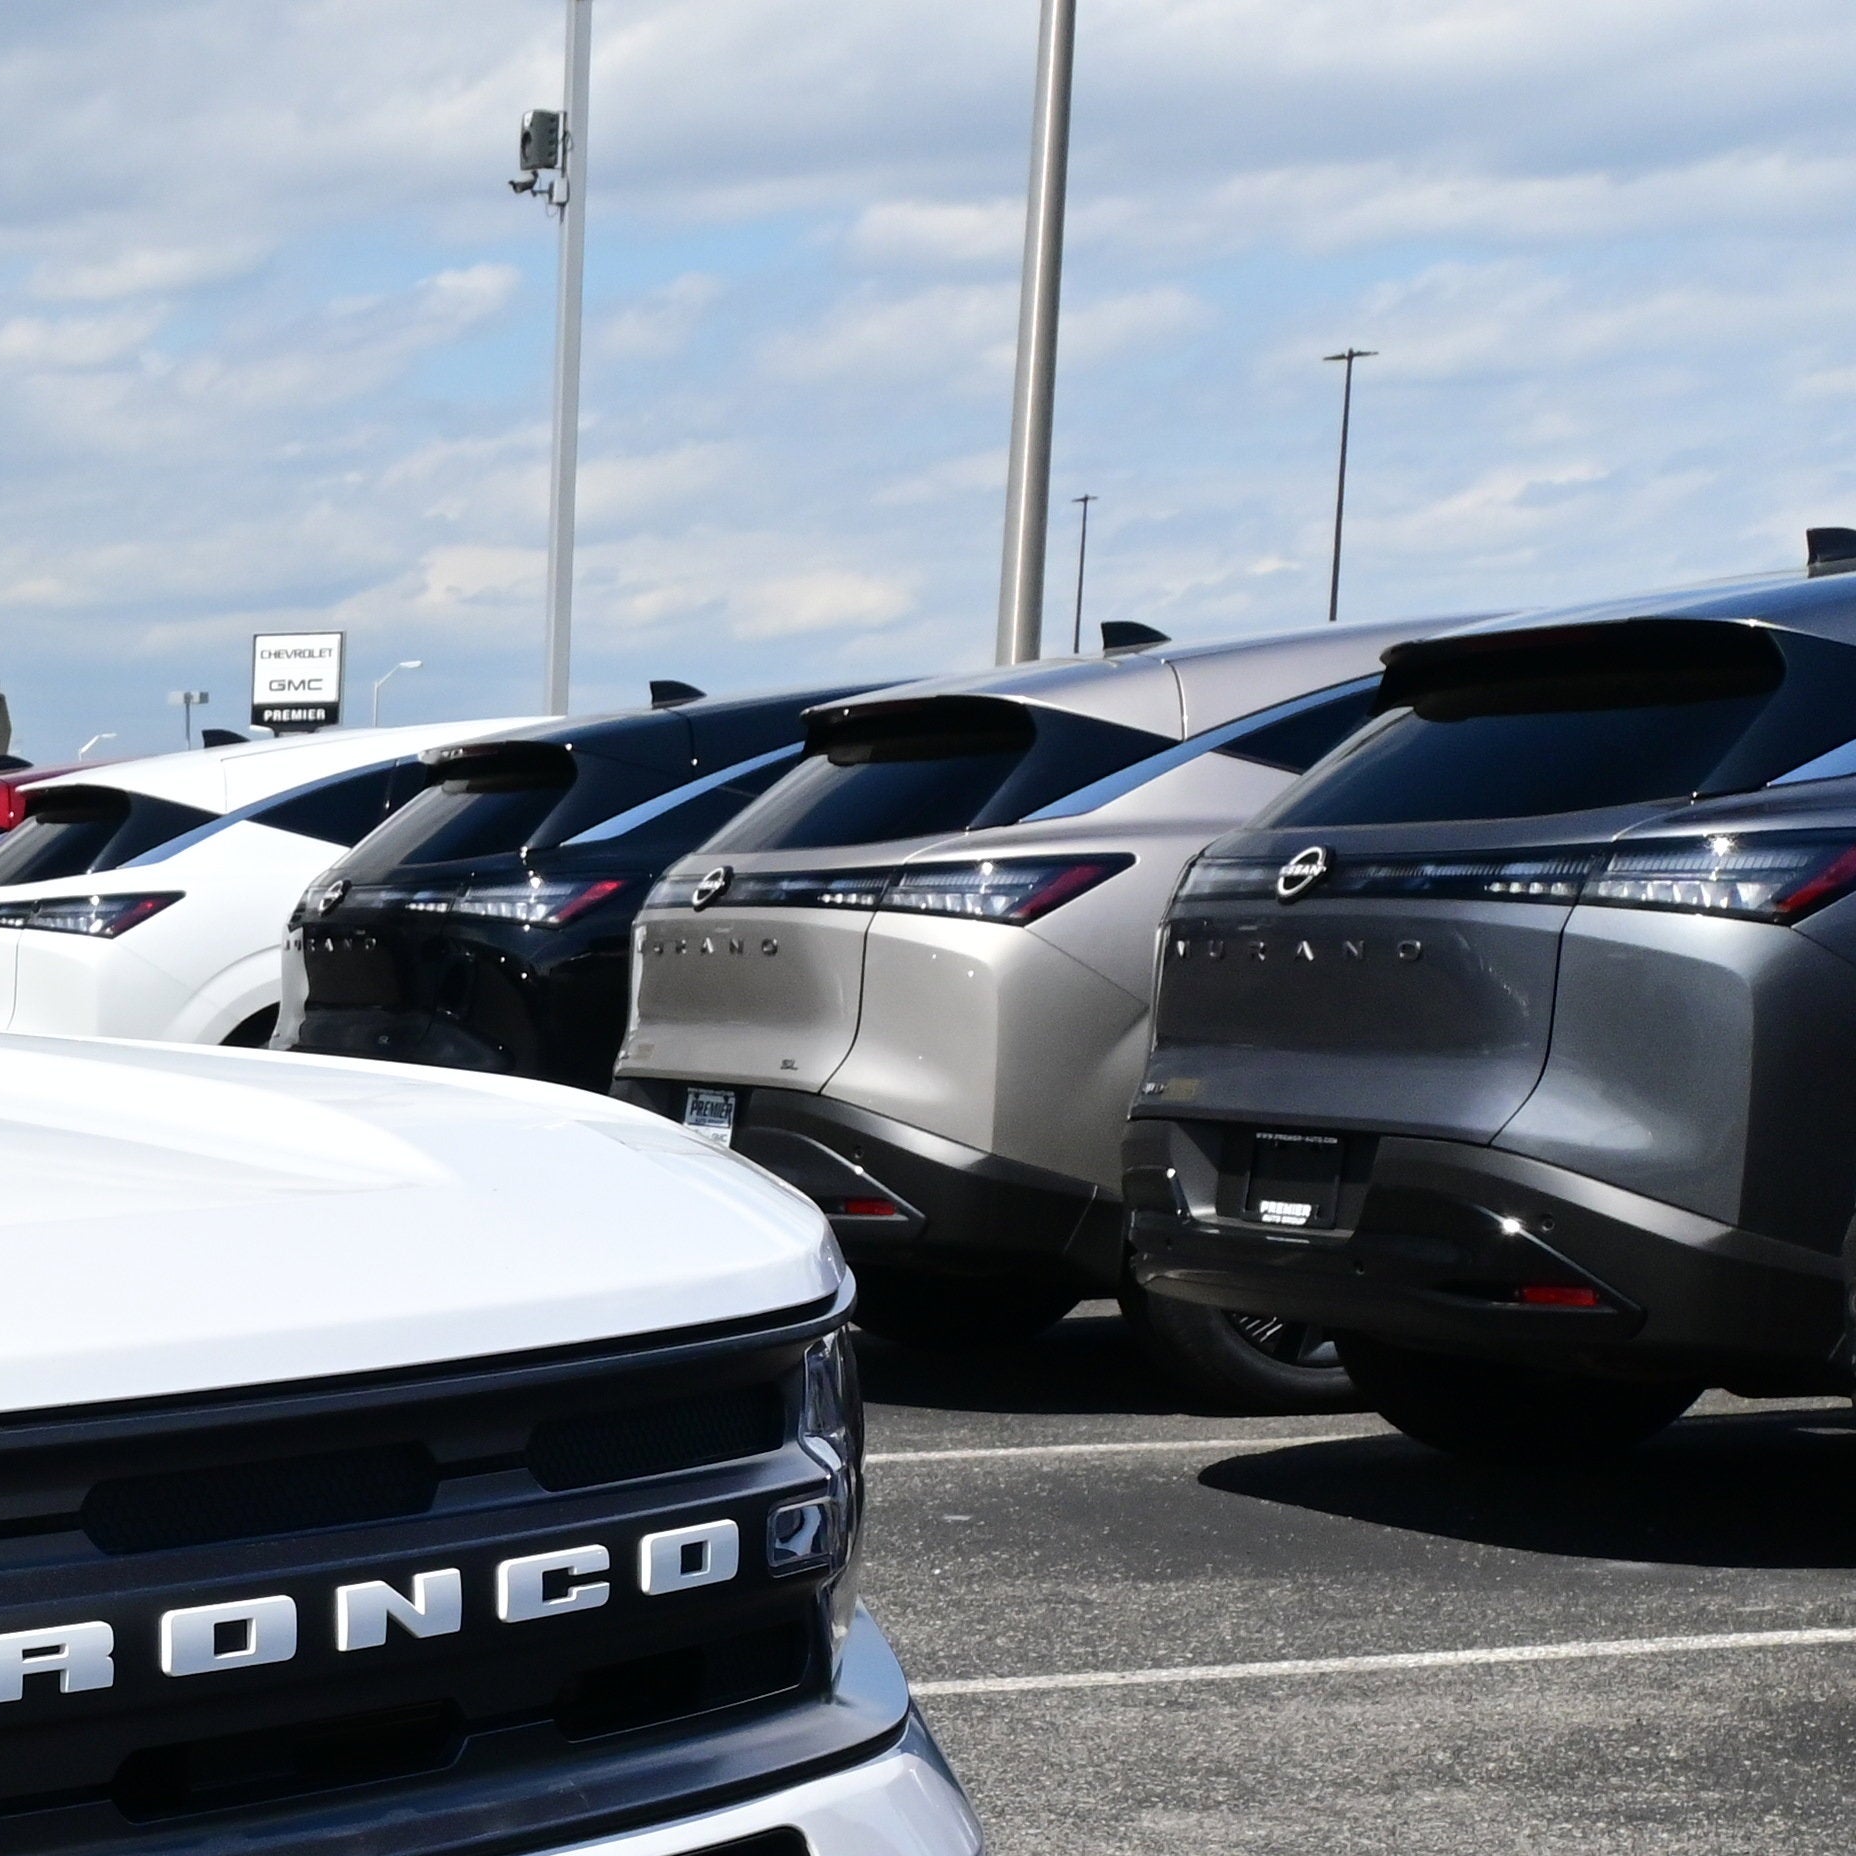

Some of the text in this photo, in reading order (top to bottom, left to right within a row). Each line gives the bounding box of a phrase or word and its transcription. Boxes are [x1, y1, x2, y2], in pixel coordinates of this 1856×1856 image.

[260, 647, 334, 661] CHEVROLET
[268, 678, 324, 692] GMC
[263, 707, 326, 722] PREMIER
[690, 1099, 733, 1119] PREMIER
[1260, 1200, 1312, 1217] PREMIER
